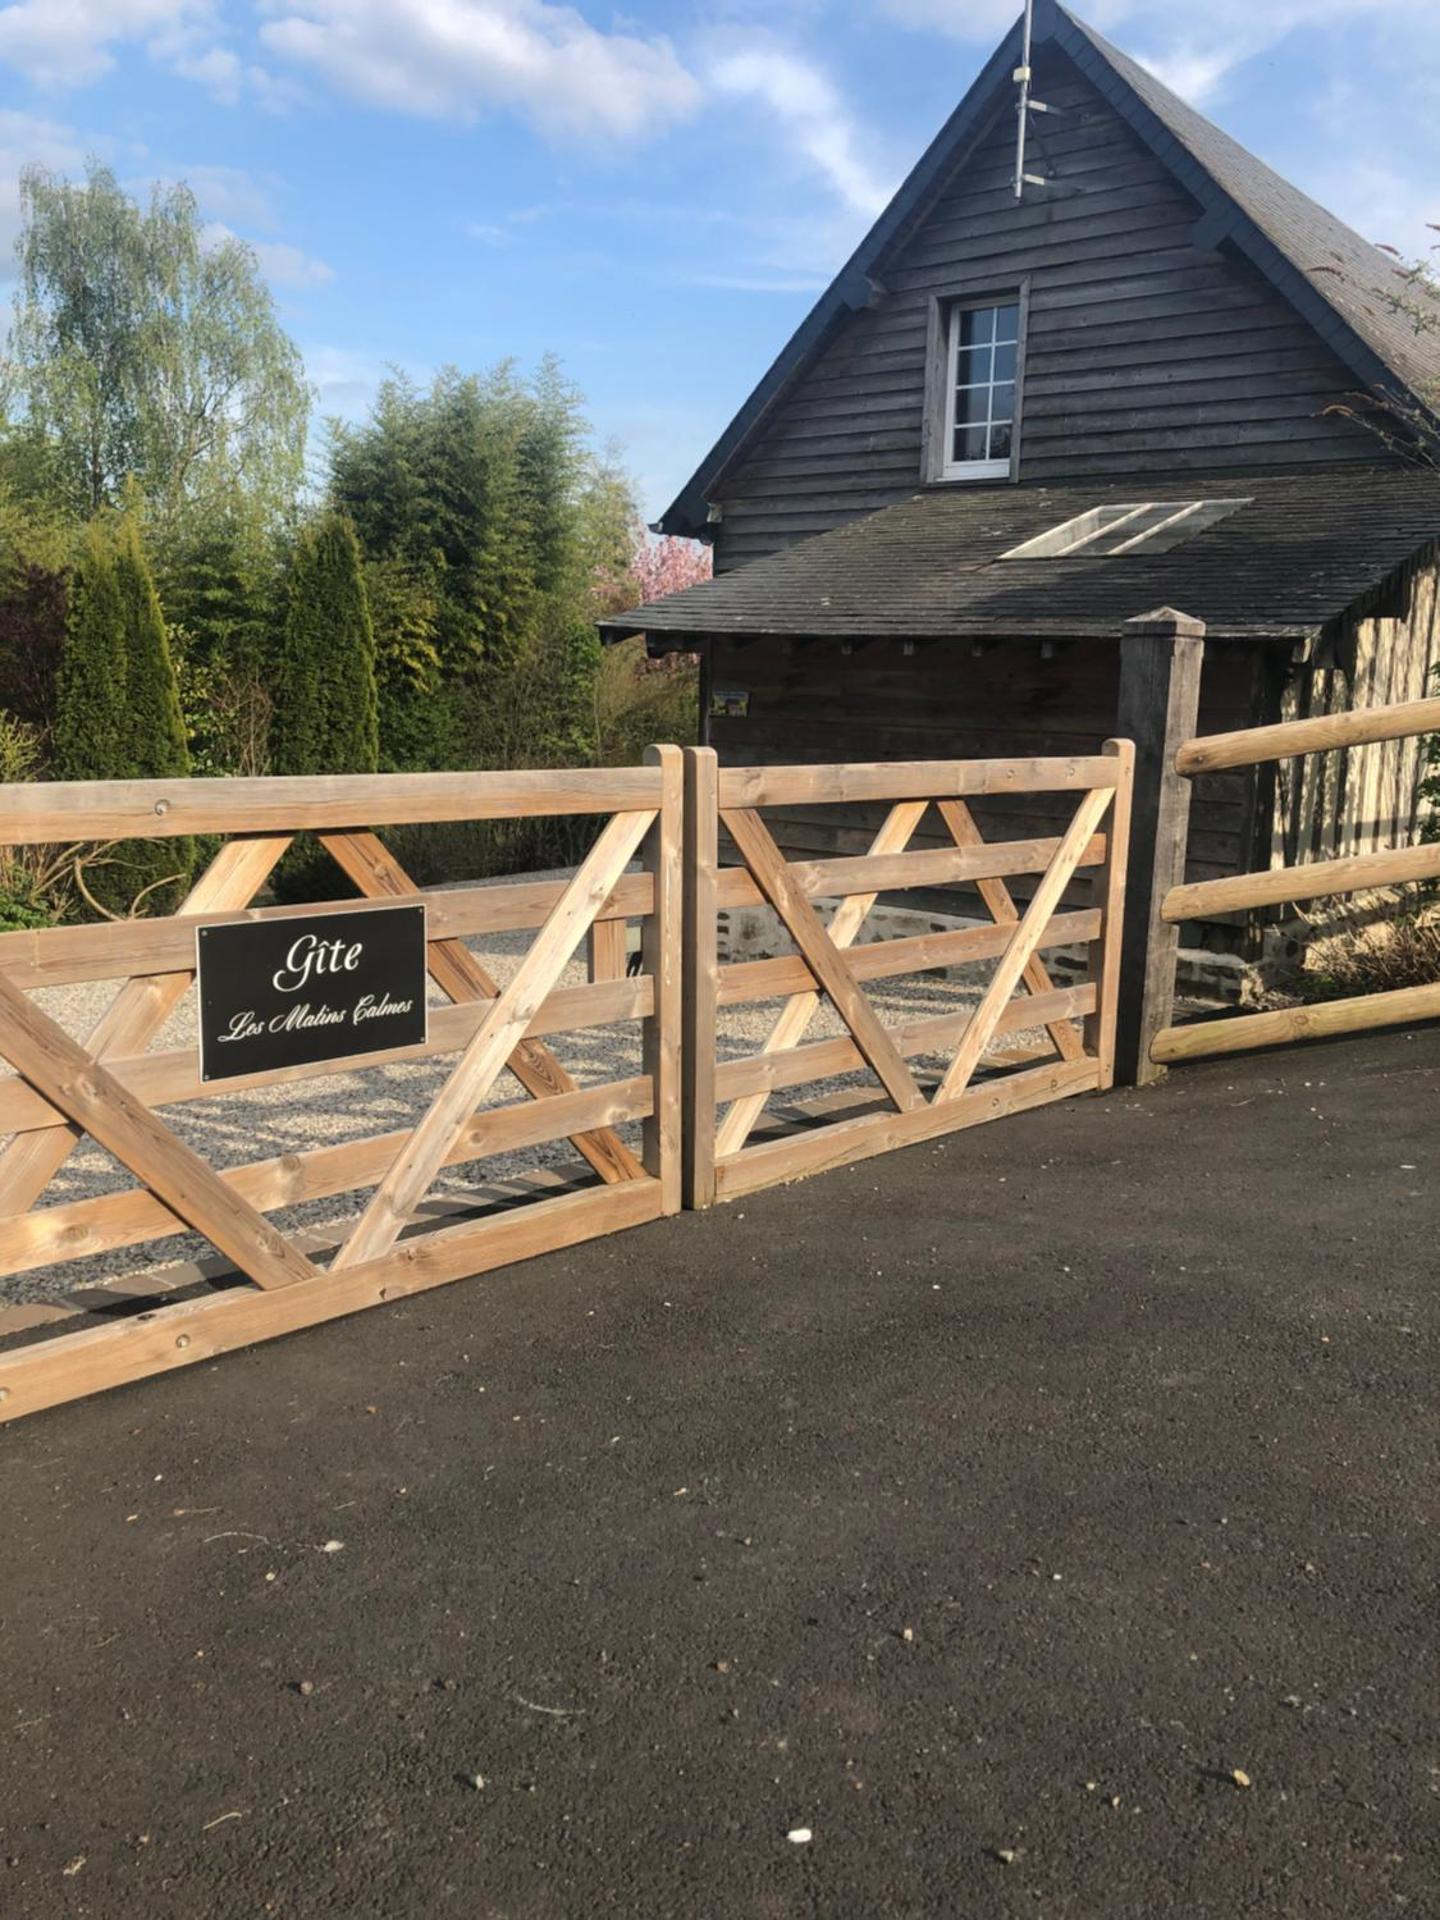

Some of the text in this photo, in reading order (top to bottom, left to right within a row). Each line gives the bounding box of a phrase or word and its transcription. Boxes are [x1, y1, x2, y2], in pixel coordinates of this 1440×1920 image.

[272, 934, 363, 992] Gîte
[217, 992, 413, 1043] Les Matins Calmes
